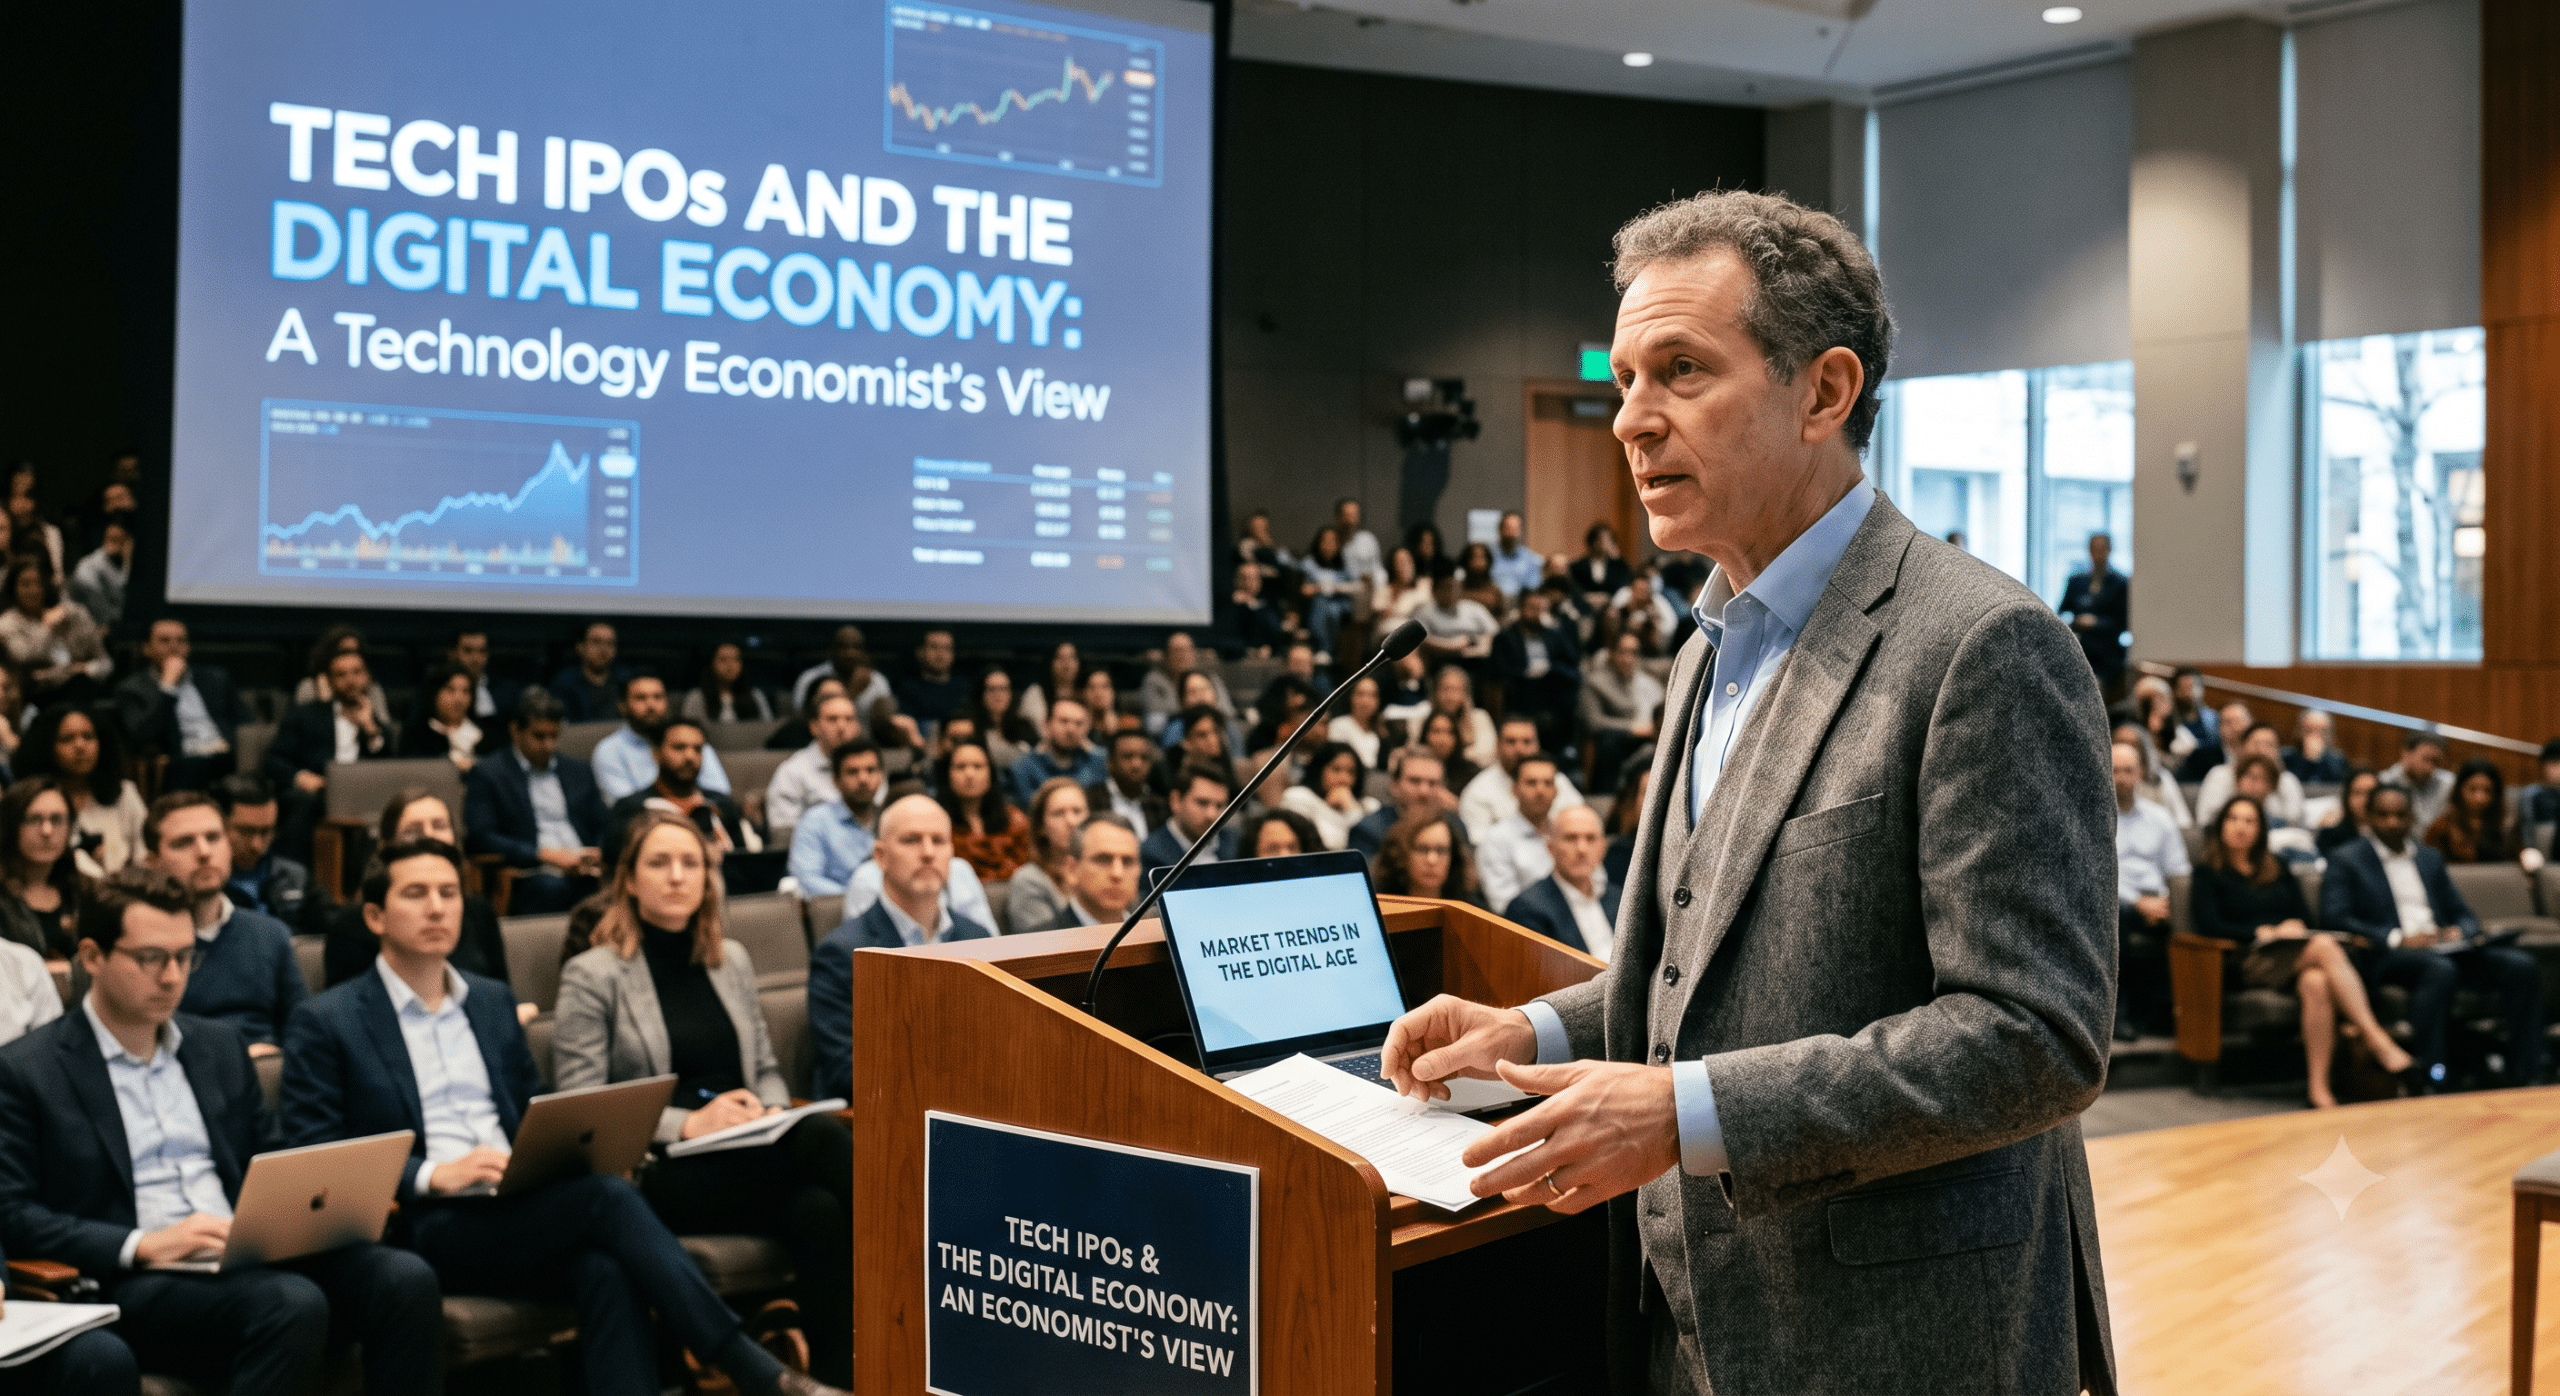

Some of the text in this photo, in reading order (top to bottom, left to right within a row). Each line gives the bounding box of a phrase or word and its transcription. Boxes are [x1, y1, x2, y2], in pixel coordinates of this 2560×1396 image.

[270, 102, 1073, 266] TECH IPOs AND THE
[271, 199, 1083, 350] DIGITAL ECONOMY:
[266, 308, 1111, 422] A Technology Economist's View
[1200, 922, 1361, 958] MARKET TRENDS IN
[1218, 948, 1357, 981] THE DIGITAL AGE
[937, 1242, 1239, 1335] THE DIGITAL ECONOMY:
[1005, 1215, 1160, 1275] TECH IPOs &
[940, 1284, 1234, 1377] AN ECONOMIST'S VIEW
